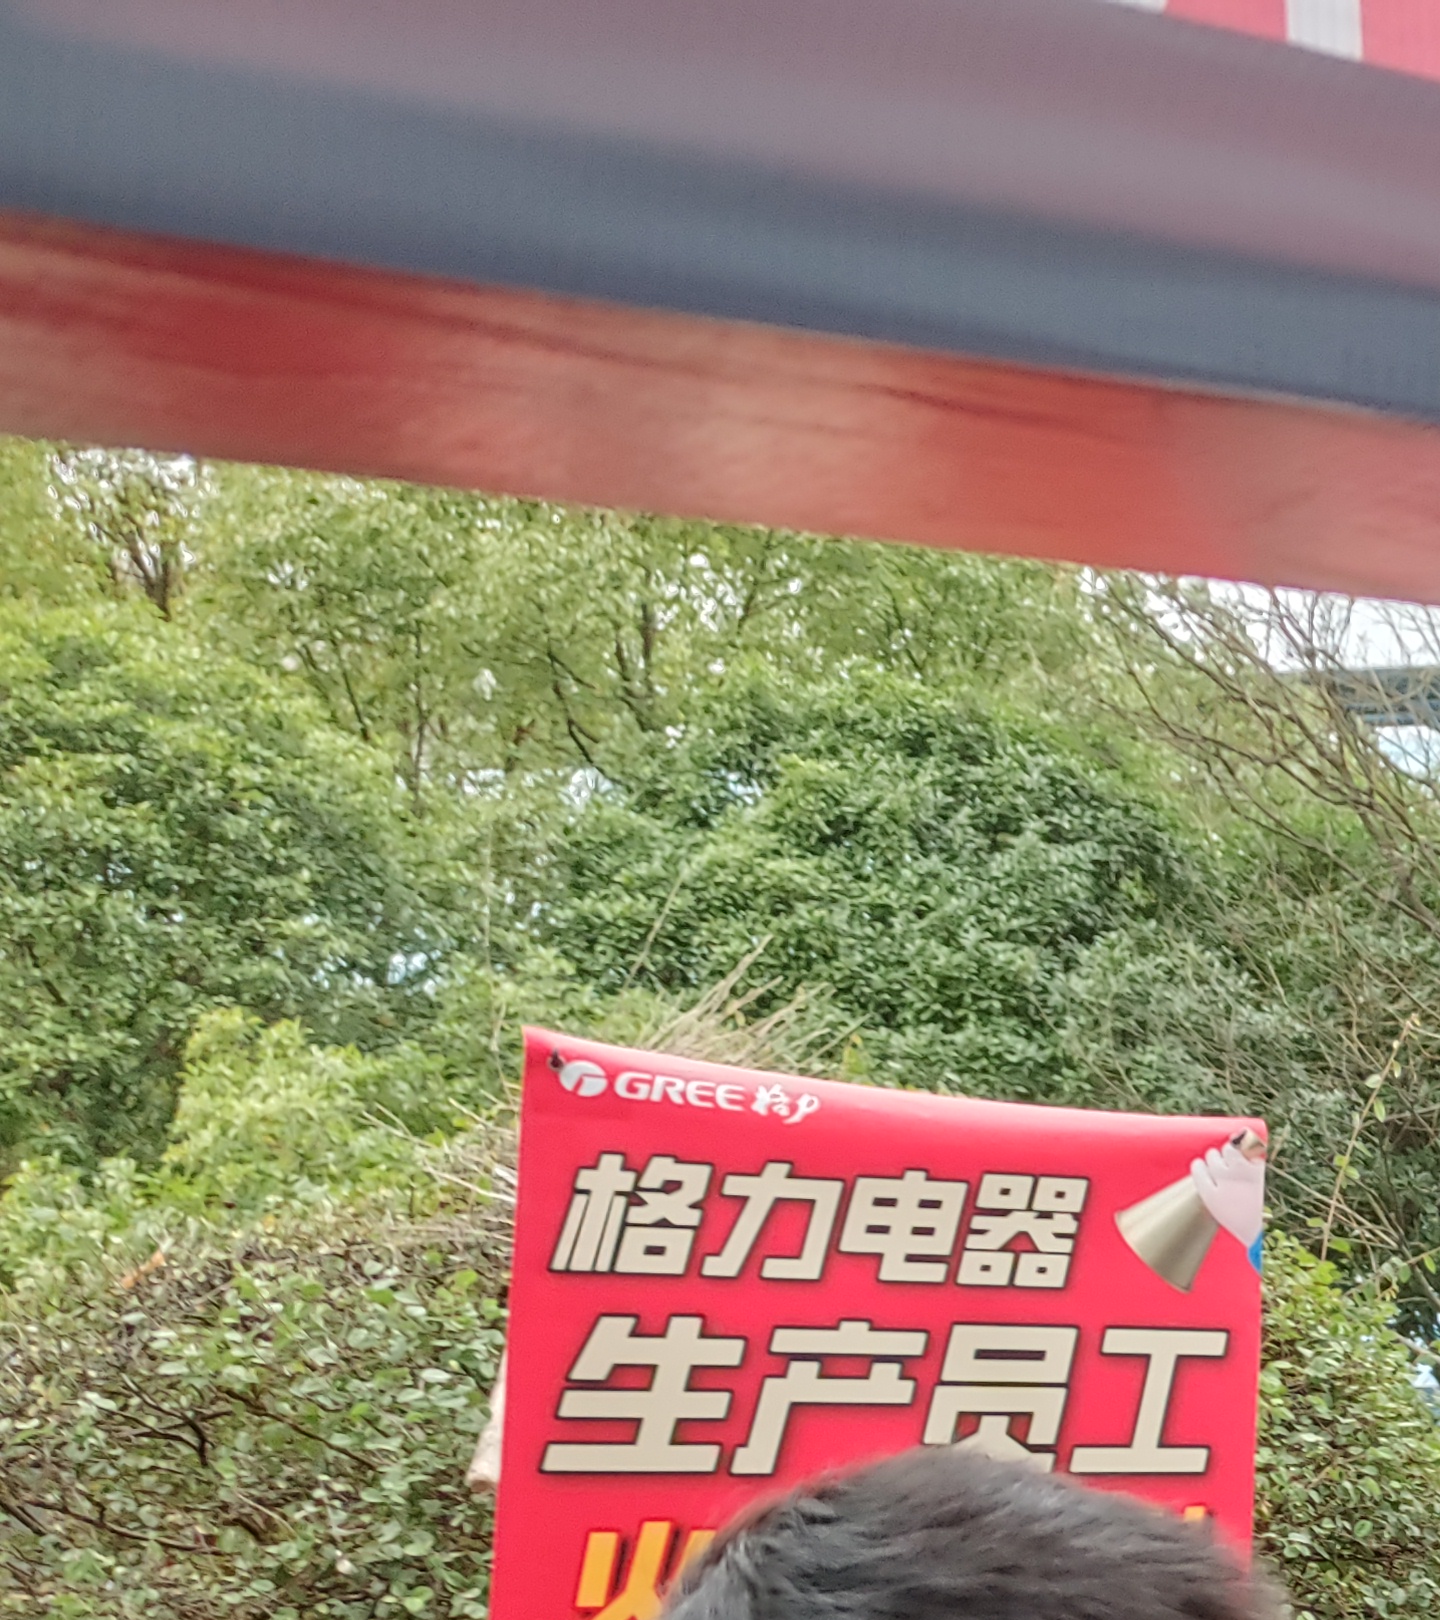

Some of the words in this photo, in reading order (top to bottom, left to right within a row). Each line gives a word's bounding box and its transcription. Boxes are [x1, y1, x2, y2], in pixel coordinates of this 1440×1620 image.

[614, 1071, 746, 1111] GREE
[548, 1151, 1092, 1291] 格力电器
[538, 1311, 1228, 1477] 生产员工
